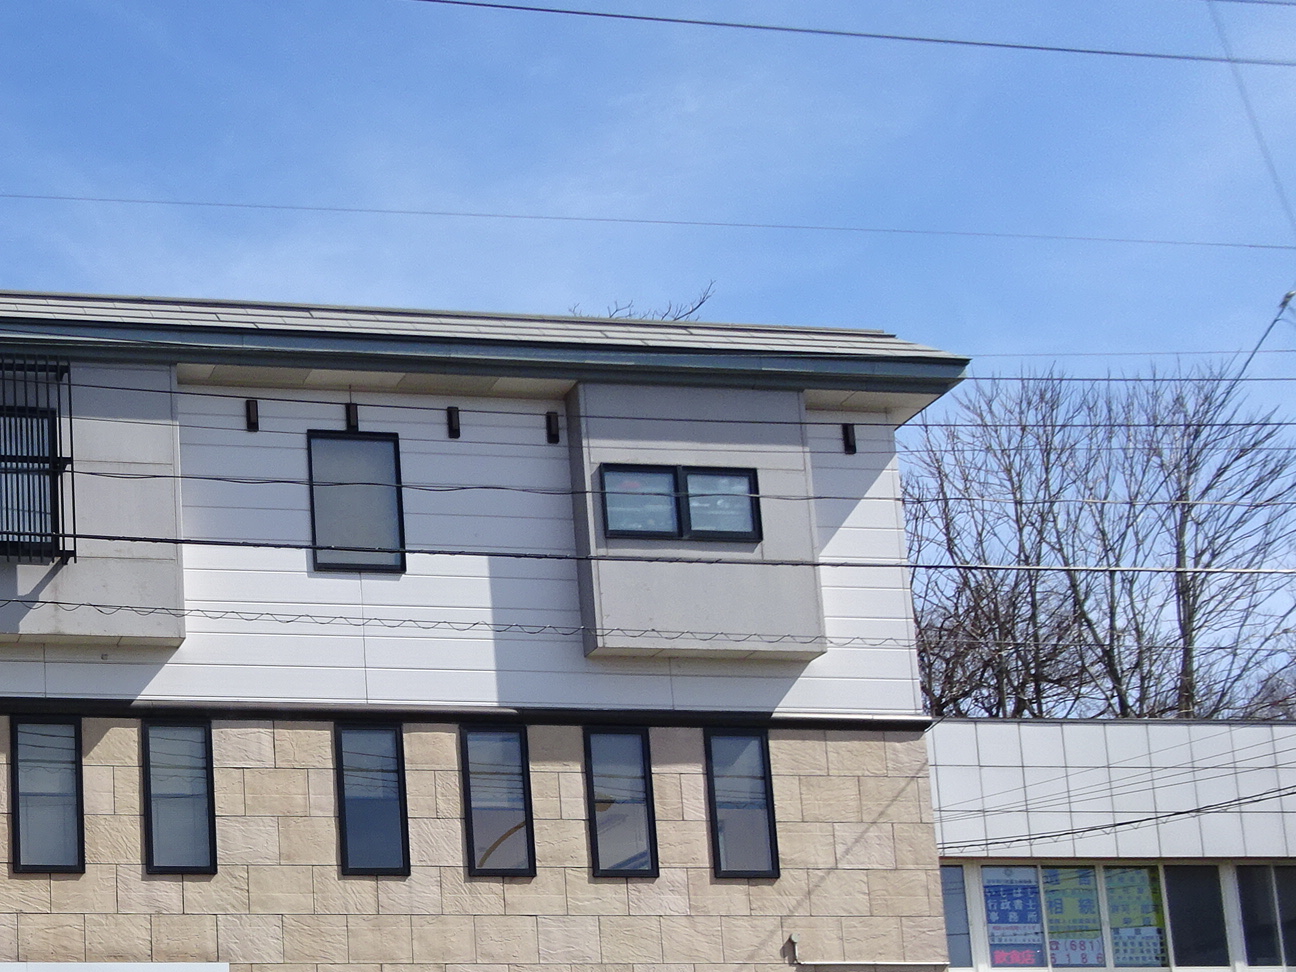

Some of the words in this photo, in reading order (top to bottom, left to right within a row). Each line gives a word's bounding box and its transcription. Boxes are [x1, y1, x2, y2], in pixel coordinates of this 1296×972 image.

[987, 899, 1037, 911] 行政書士
[989, 911, 1038, 923] 事務所
